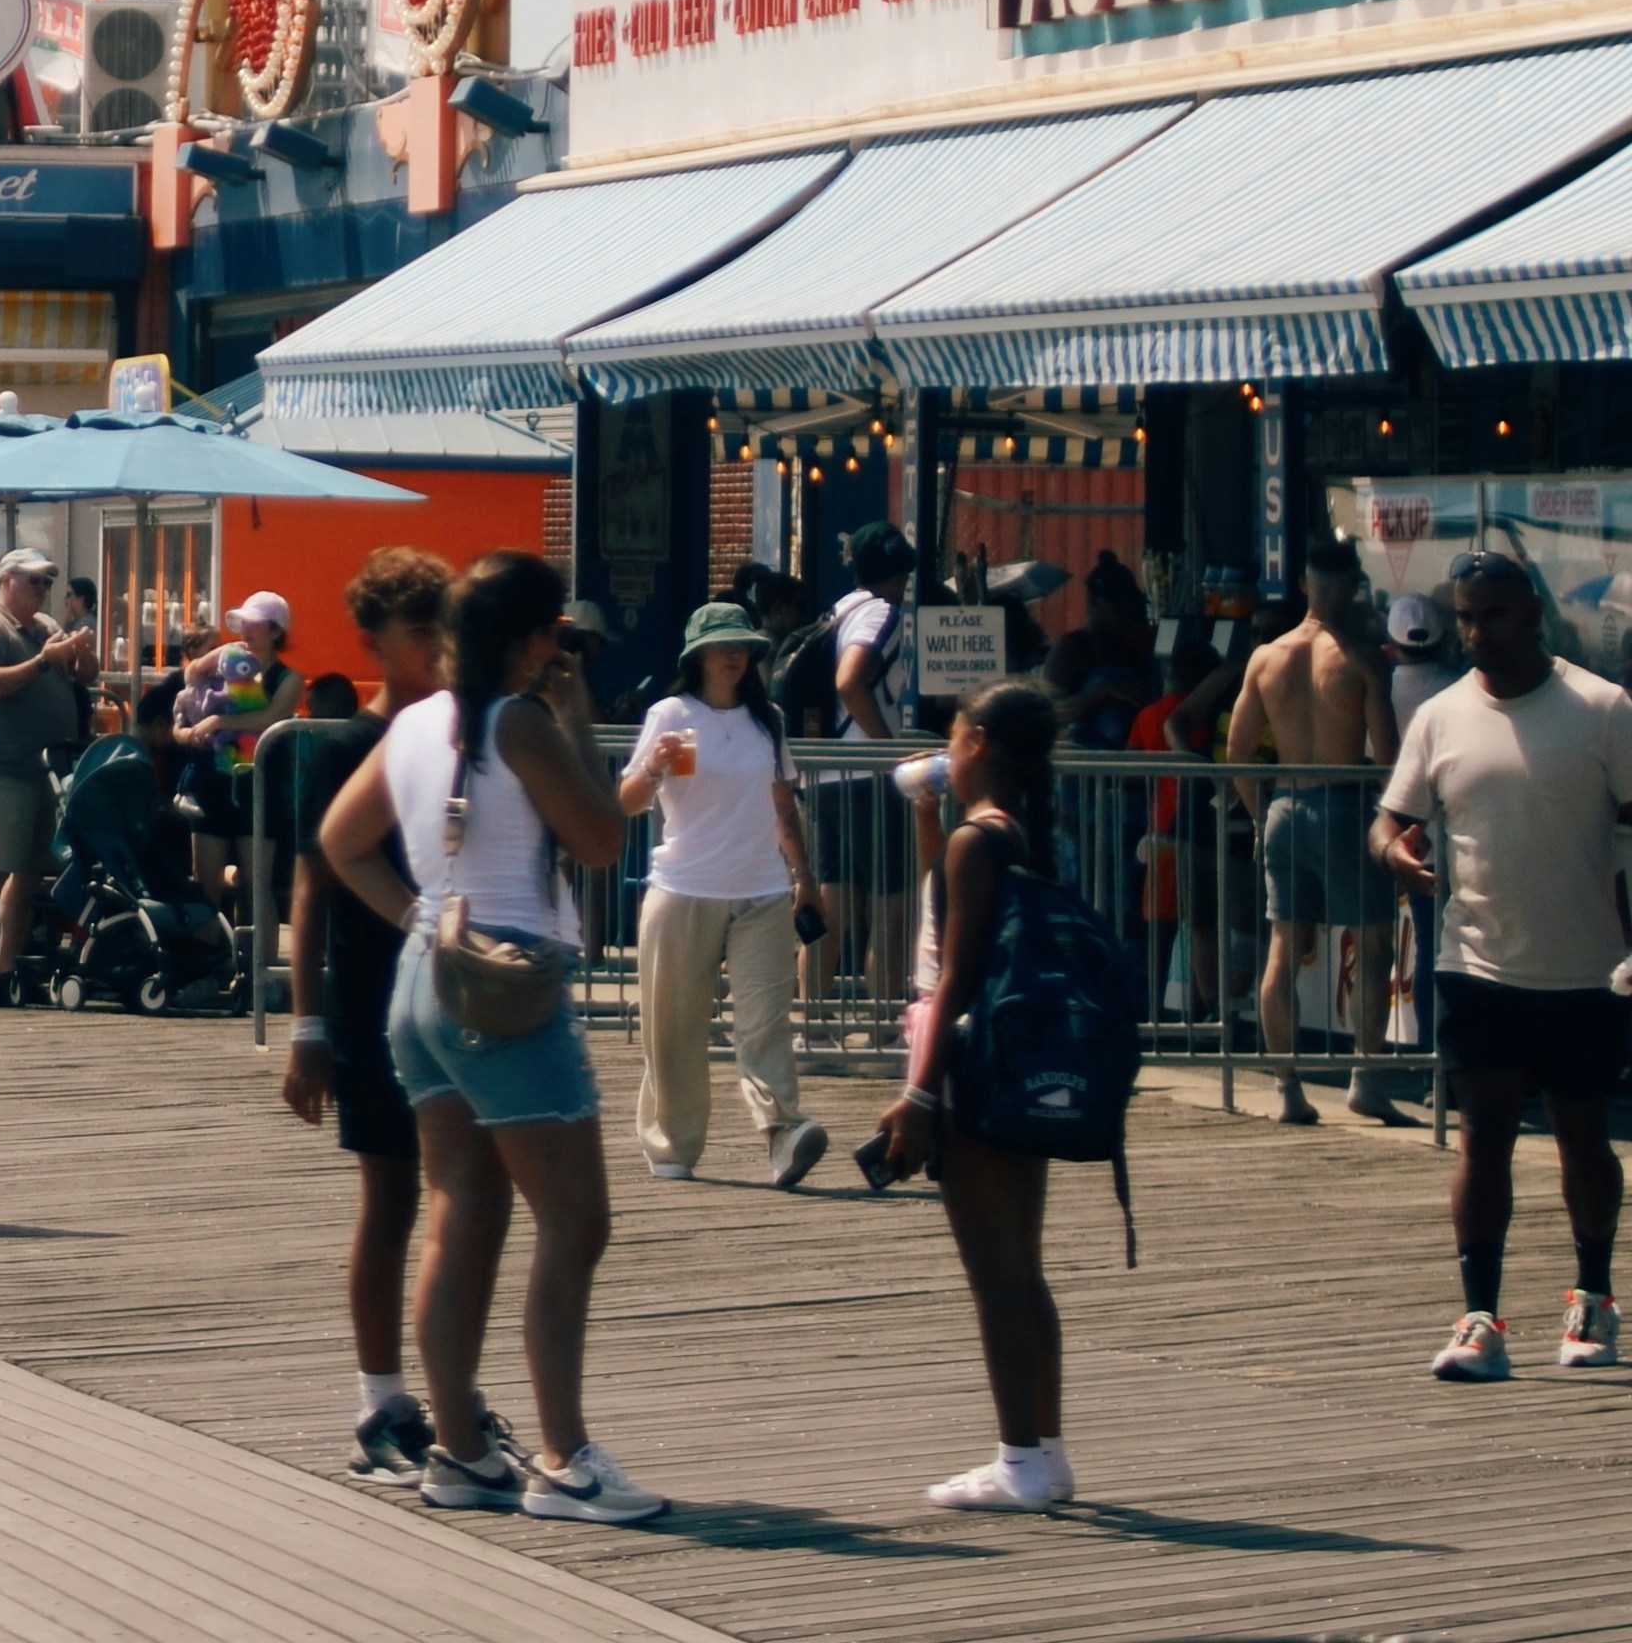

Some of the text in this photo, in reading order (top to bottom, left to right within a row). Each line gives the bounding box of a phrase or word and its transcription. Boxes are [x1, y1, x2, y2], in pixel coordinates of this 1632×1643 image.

[573, 6, 616, 68] FRIES
[1371, 496, 1430, 539] PICK UP
[939, 615, 982, 627] PLEASE
[926, 635, 995, 652] WAIT HERE
[1024, 1071, 1088, 1092] RANDOLPH
